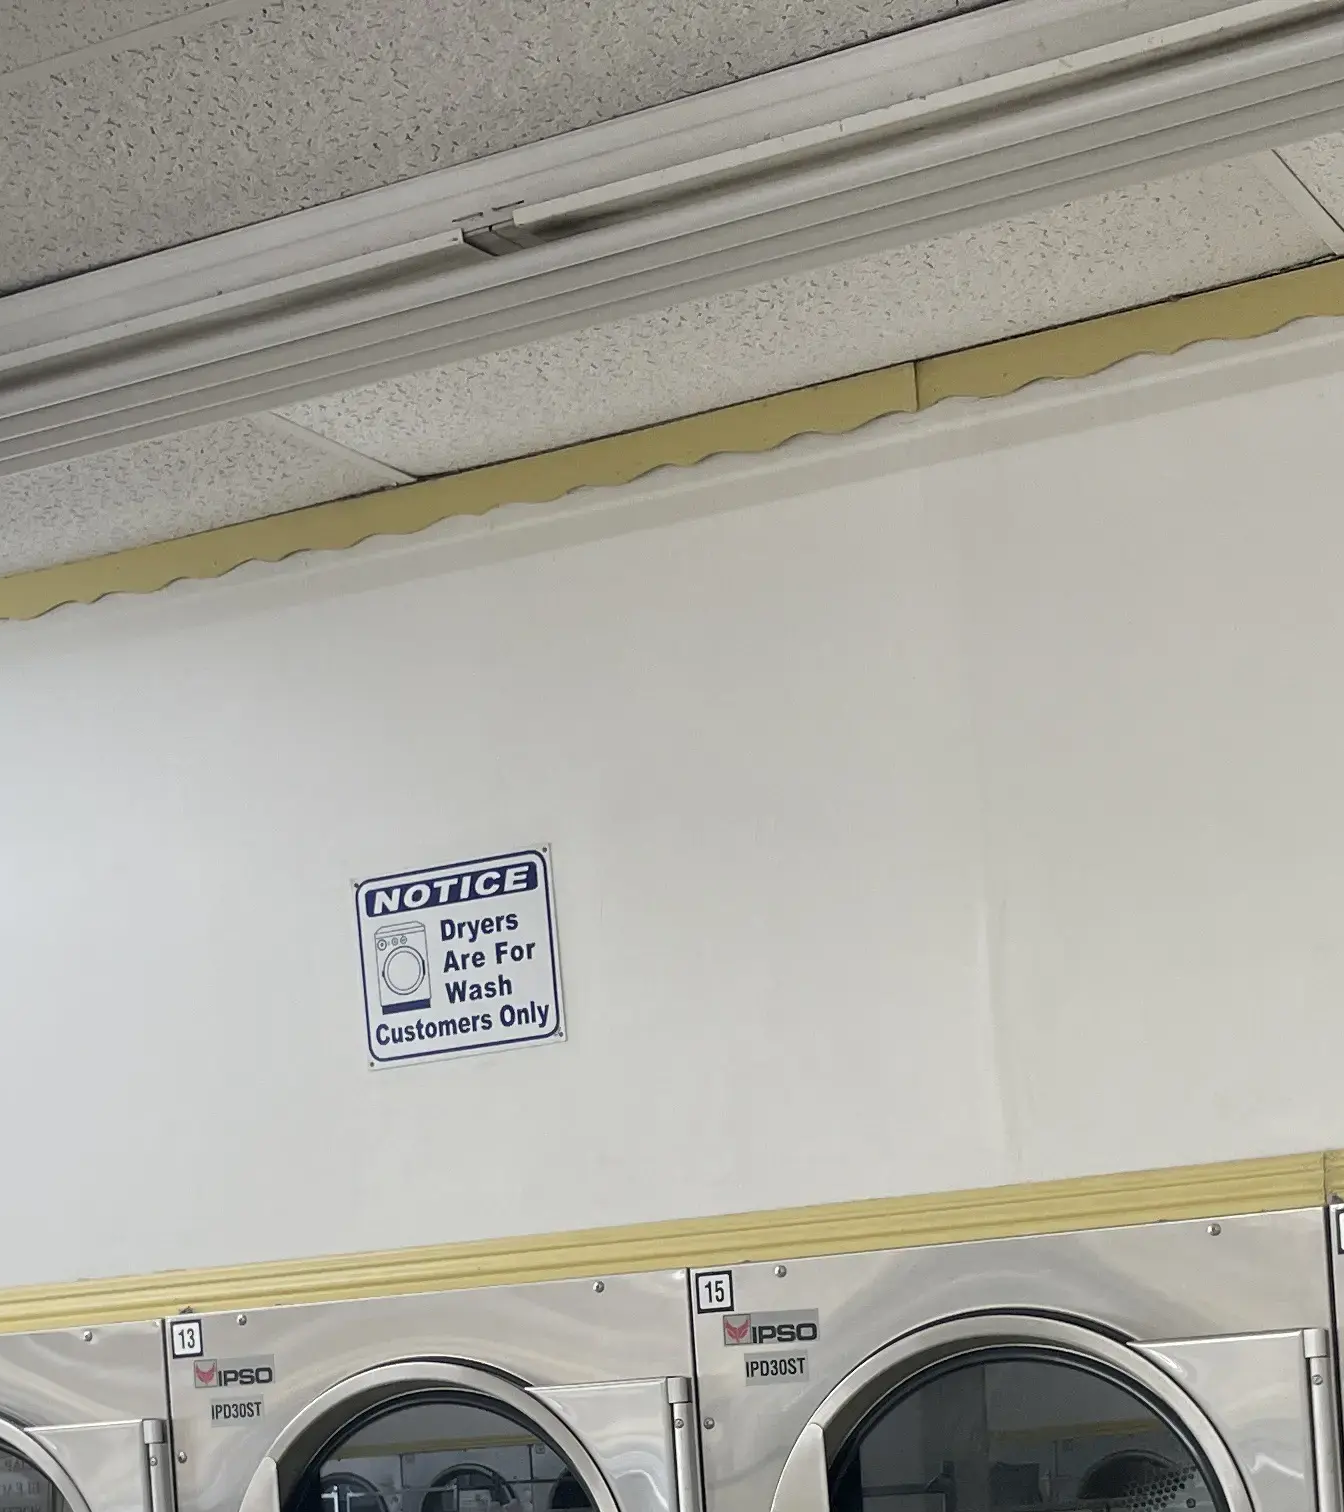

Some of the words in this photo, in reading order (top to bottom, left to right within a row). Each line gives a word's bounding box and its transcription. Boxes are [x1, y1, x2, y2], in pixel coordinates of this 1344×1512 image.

[373, 865, 529, 915] NOTICE
[440, 913, 519, 943] Dryers
[443, 950, 486, 973] Are
[495, 941, 536, 964] For
[445, 975, 513, 1004] Wash
[375, 1012, 493, 1046] Customers
[499, 1001, 550, 1029] Only
[705, 1280, 725, 1304] 15
[178, 1328, 196, 1349] 13
[751, 1322, 818, 1344] IPSO
[218, 1367, 273, 1387] IPSO
[745, 1357, 806, 1378] IPD30ST
[211, 1401, 262, 1420] IPD30ST
